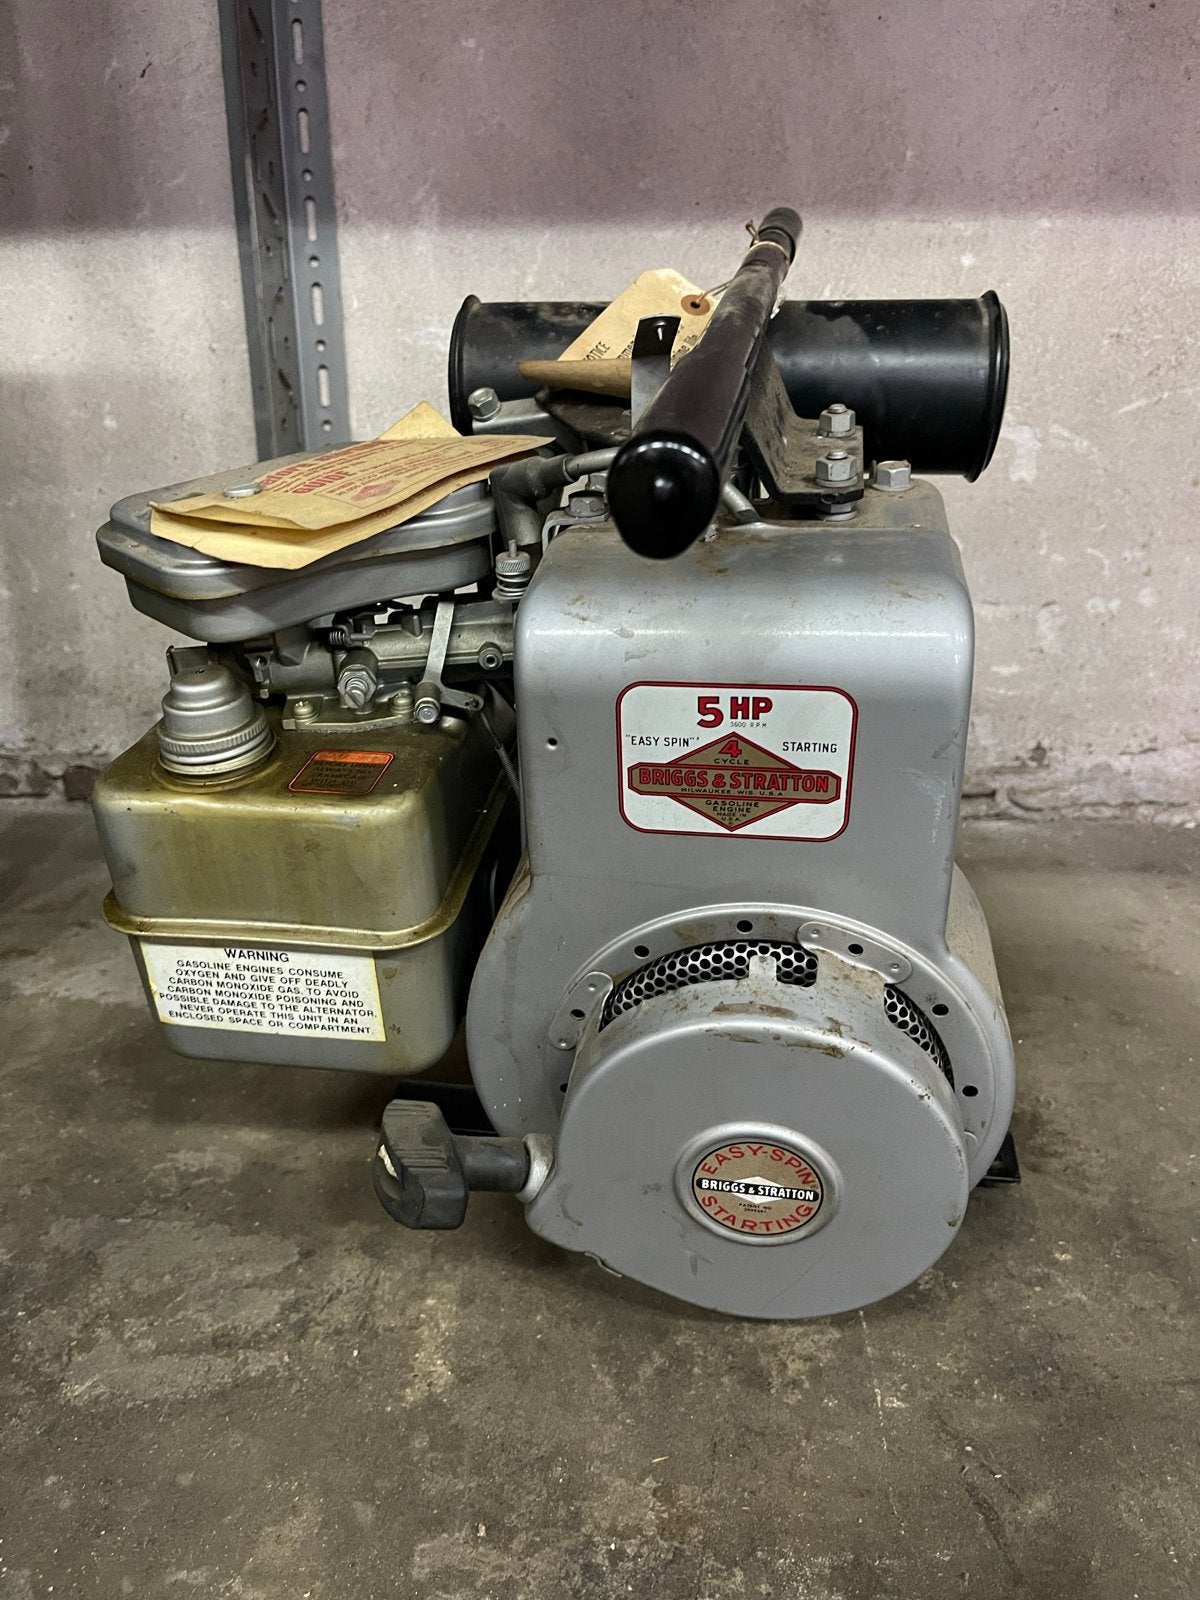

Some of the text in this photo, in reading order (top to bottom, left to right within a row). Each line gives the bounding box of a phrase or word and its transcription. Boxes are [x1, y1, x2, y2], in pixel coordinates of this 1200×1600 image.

[291, 470, 357, 494] GUIDE
[697, 696, 773, 728] 5 HP
[718, 740, 742, 758] 4
[782, 741, 838, 754] STARTING
[714, 758, 750, 766] CYCLE
[638, 768, 830, 793] BRIGGS & STRATTON
[705, 800, 760, 808] GASOLINE
[712, 806, 752, 814] ENGINE
[224, 948, 289, 963] WARNING
[175, 968, 348, 989] OXYGEN AND GIVE OFF DEADLY
[177, 959, 344, 979] GASOLINE ENGINES CONSUME
[167, 985, 364, 1008] CARBON MONOXIDE POISONING AND
[169, 977, 213, 988] CARBON
[217, 981, 274, 992] MONOXIDE
[307, 987, 322, 996] TO
[325, 989, 359, 999] AVOID
[159, 992, 210, 1005] POSSIBLE
[213, 998, 258, 1009] DAMAGE
[261, 1002, 275, 1010] TO
[279, 1003, 299, 1012] THE
[168, 1010, 224, 1022] ENCLOSED
[229, 1016, 263, 1026] SPACE
[268, 1020, 283, 1028] OR
[180, 1003, 214, 1013] NEVER
[218, 1007, 266, 1018] OPERATE
[271, 1011, 295, 1020] THIS
[299, 1014, 323, 1022] UNIT
[327, 1016, 338, 1024] IN
[700, 1144, 816, 1186] EASY-SPIN
[701, 1178, 815, 1201] BRIGGS & STRATTON
[701, 1195, 814, 1232] STARTING
